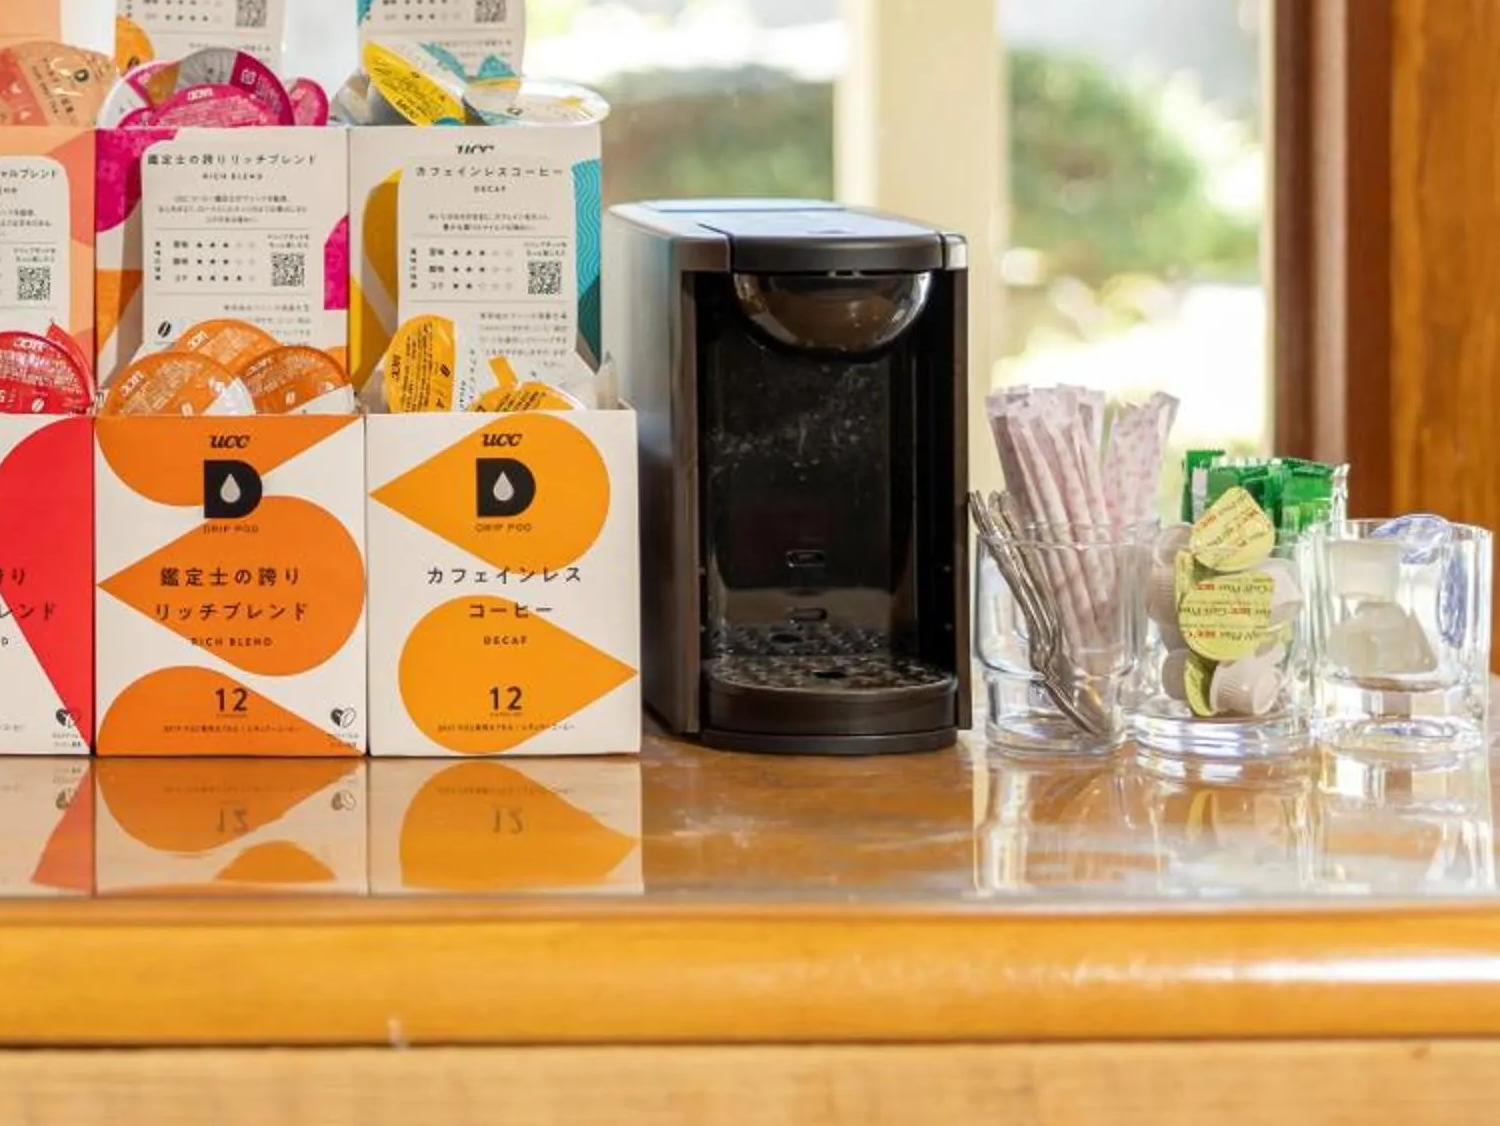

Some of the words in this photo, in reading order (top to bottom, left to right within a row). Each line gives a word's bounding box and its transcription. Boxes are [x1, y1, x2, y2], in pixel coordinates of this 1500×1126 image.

[161, 567, 300, 587] 鑑定士の誇り
[428, 566, 581, 585] カフェインレス
[156, 602, 308, 621] リッチブレンド
[469, 602, 553, 619] コーヒー
[191, 637, 223, 647] RICH
[230, 637, 273, 647] BLEND
[483, 635, 528, 645] DECAF
[215, 687, 248, 712] 12
[489, 686, 522, 711] 12
